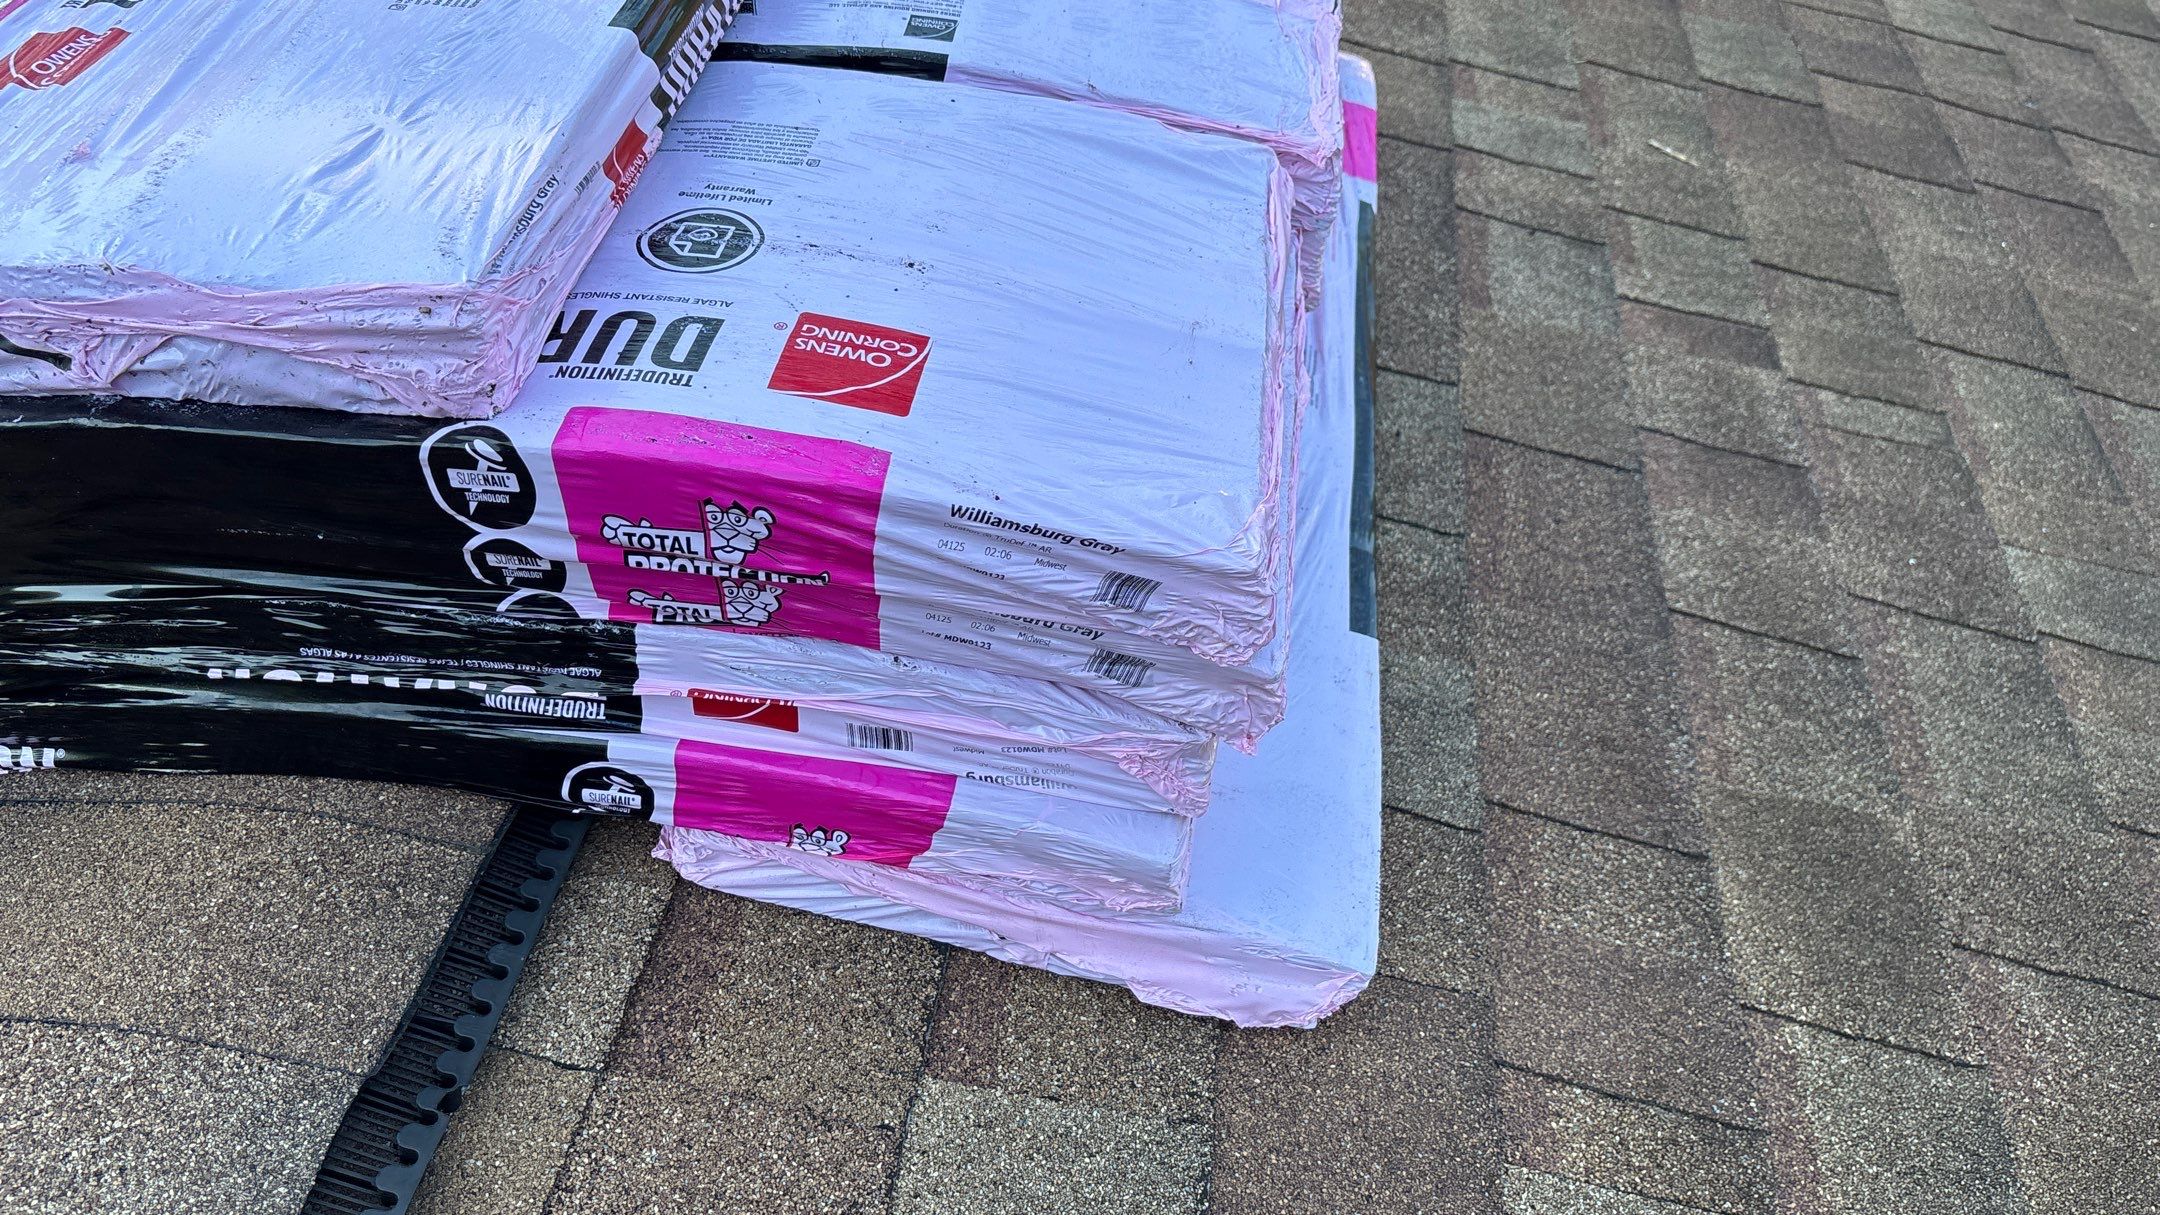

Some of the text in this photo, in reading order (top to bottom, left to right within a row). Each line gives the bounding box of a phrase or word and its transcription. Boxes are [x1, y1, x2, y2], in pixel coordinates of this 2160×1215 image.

[537, 174, 560, 199] Gray
[703, 183, 756, 195] Warranty
[678, 190, 773, 206] Limited Lifetime
[565, 291, 733, 308] ALGAE RESISTANT SHINGLES
[799, 324, 918, 357] CORNING
[792, 337, 892, 367] OWENS
[464, 492, 510, 504] TECHNOLOGY
[950, 503, 1127, 555] Williamsburg Gray
[623, 532, 699, 556] TOTAL
[937, 539, 1012, 560] 04125 02:06
[1038, 545, 1053, 553] AR
[628, 555, 825, 586] PROTEC
[1034, 558, 1067, 571] Midwest
[502, 568, 543, 579] TECHNOLOGY
[925, 612, 952, 624] 04125
[970, 621, 996, 633] 02:06
[1017, 631, 1051, 647] Midwest
[1059, 622, 1105, 641] Gray
[944, 634, 992, 650] MDW0123
[299, 647, 333, 657] ALGAS
[466, 659, 515, 670] SHINGLES
[569, 666, 602, 677] ALGAE
[485, 693, 606, 719] TRUDEFINITION
[952, 745, 985, 755] Midwest
